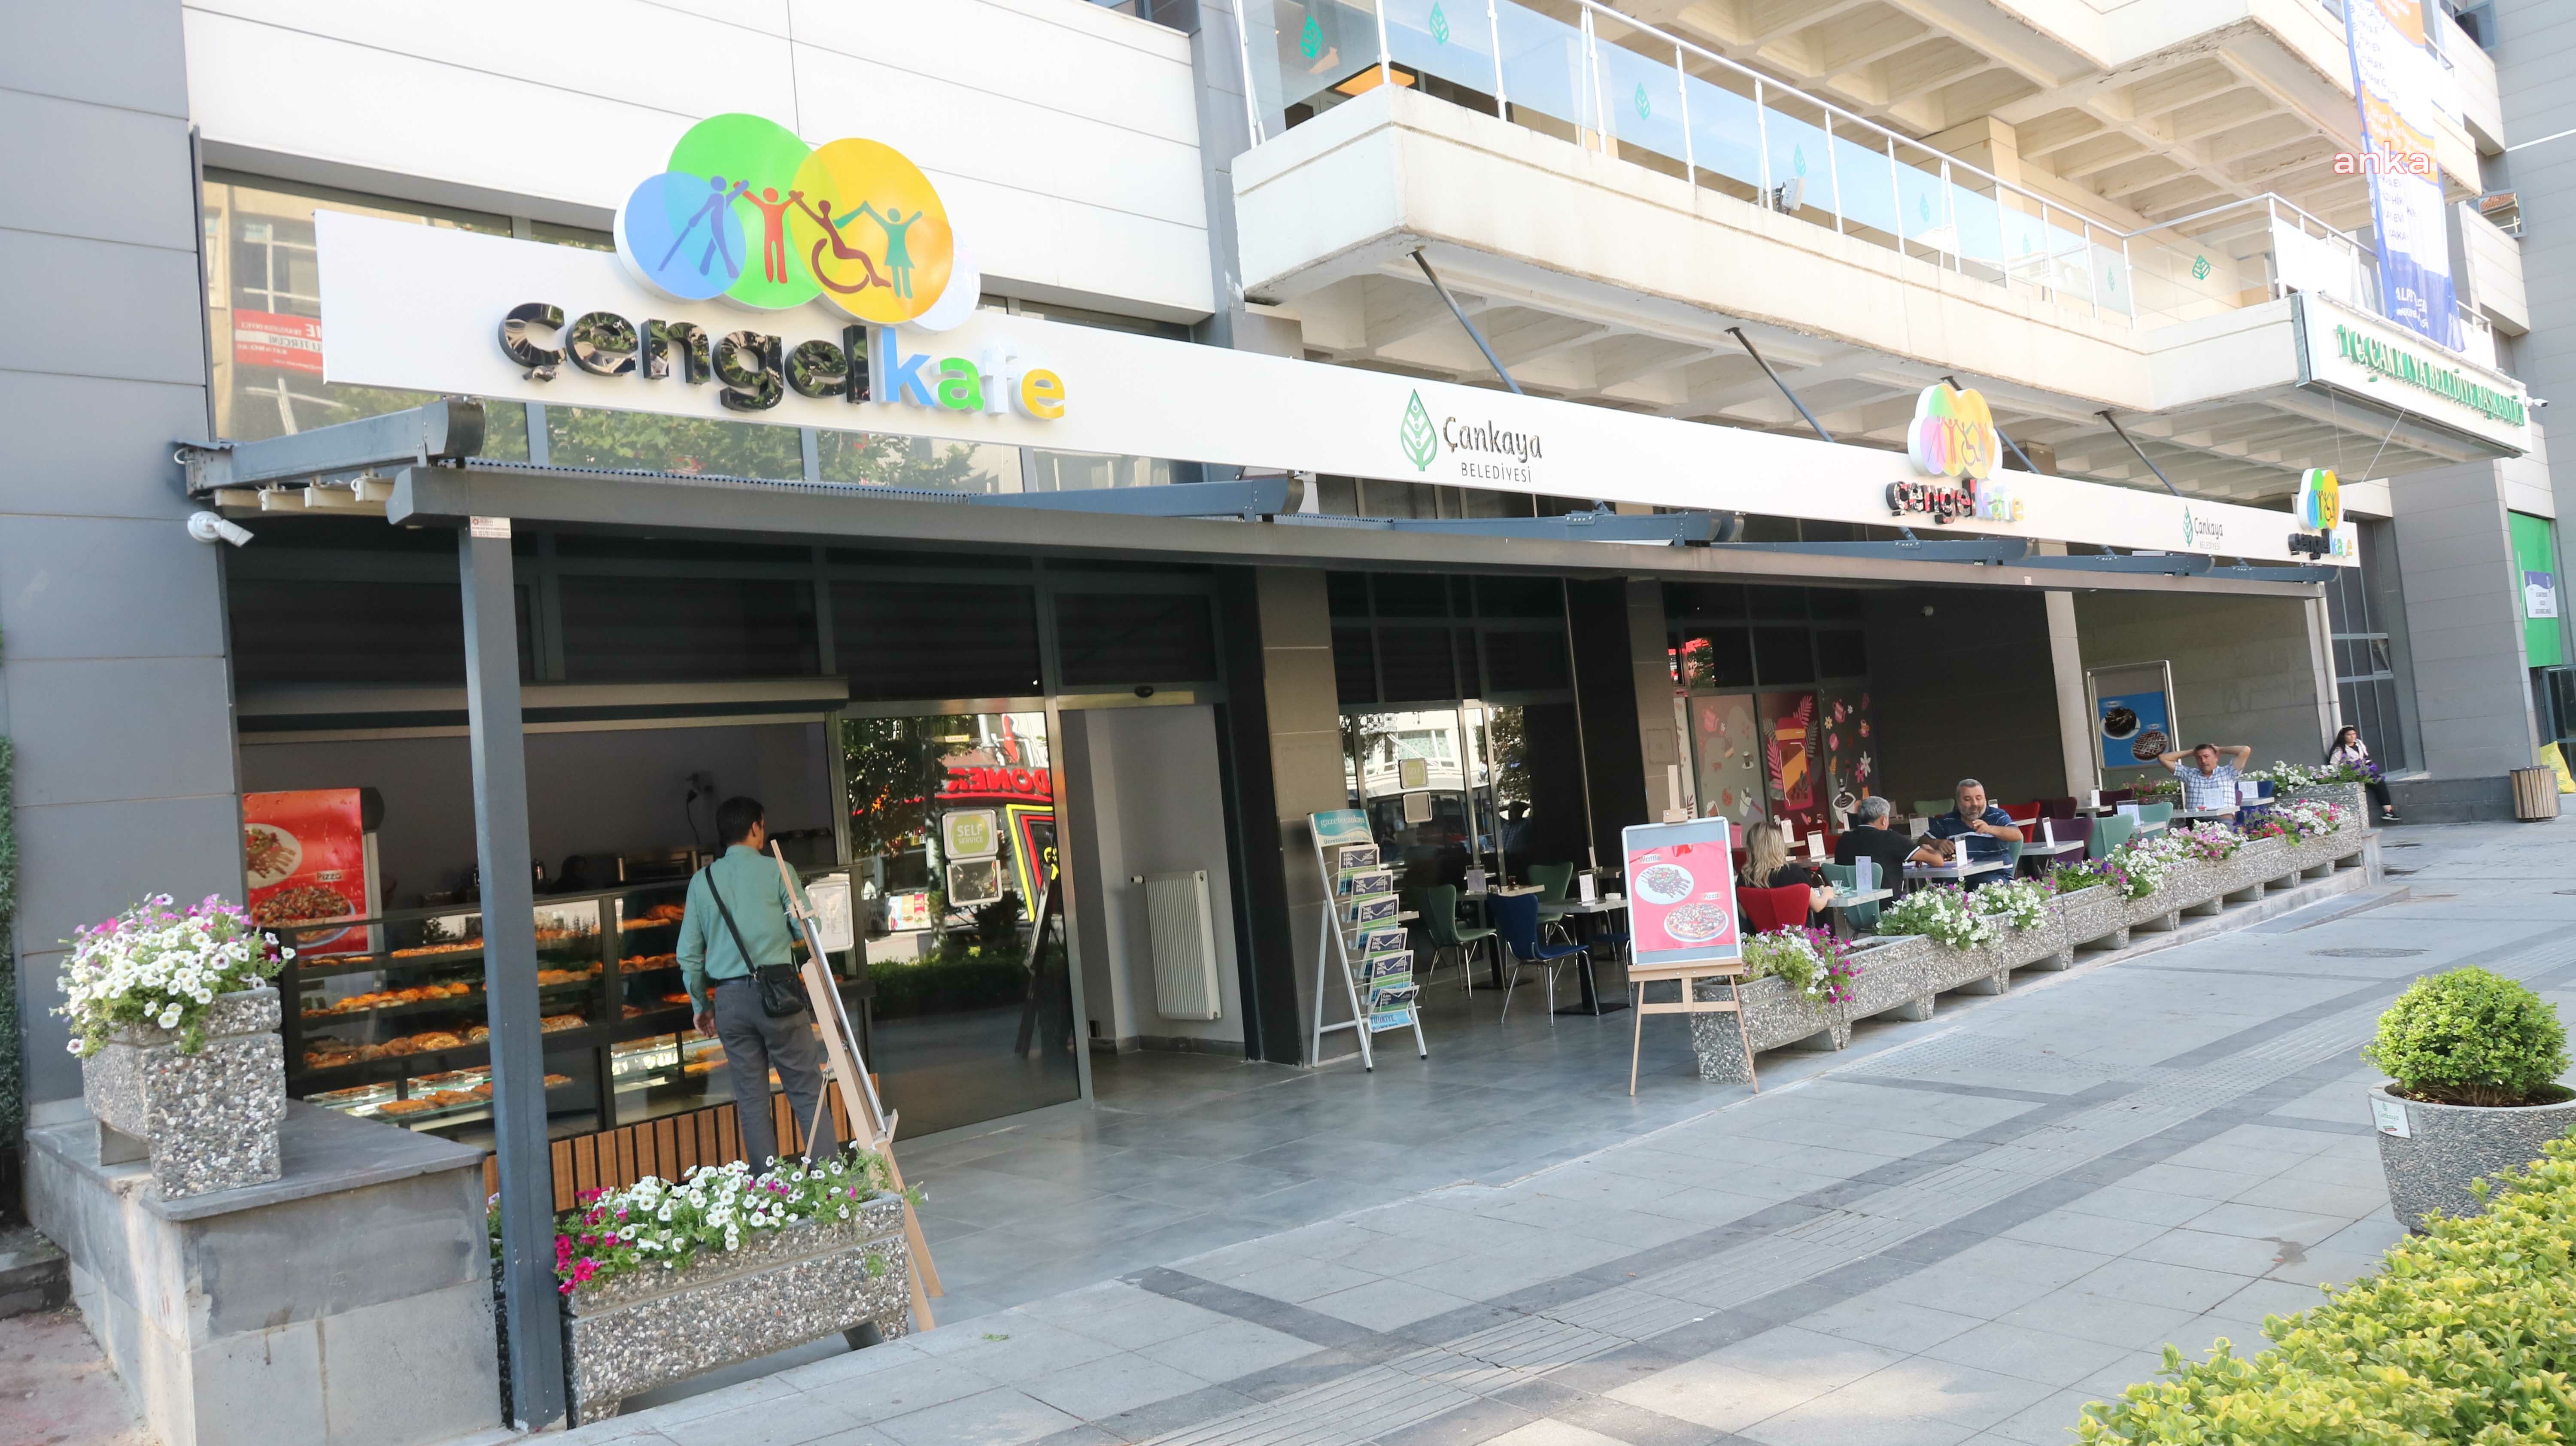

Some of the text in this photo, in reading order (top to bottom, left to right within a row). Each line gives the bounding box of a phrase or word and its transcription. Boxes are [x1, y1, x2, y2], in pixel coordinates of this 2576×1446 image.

[2363, 337, 2430, 391] ÇANKAYA
[2430, 364, 2478, 408] BELEDİYE
[1443, 416, 1542, 463] Çankaya
[1461, 462, 1531, 483] BELEDİYESİ
[2194, 517, 2223, 540] Çankaya
[957, 823, 983, 837] SELF
[958, 836, 983, 845] SERVICE
[1639, 854, 1662, 863] Waffle
[316, 872, 342, 881] Pizza
